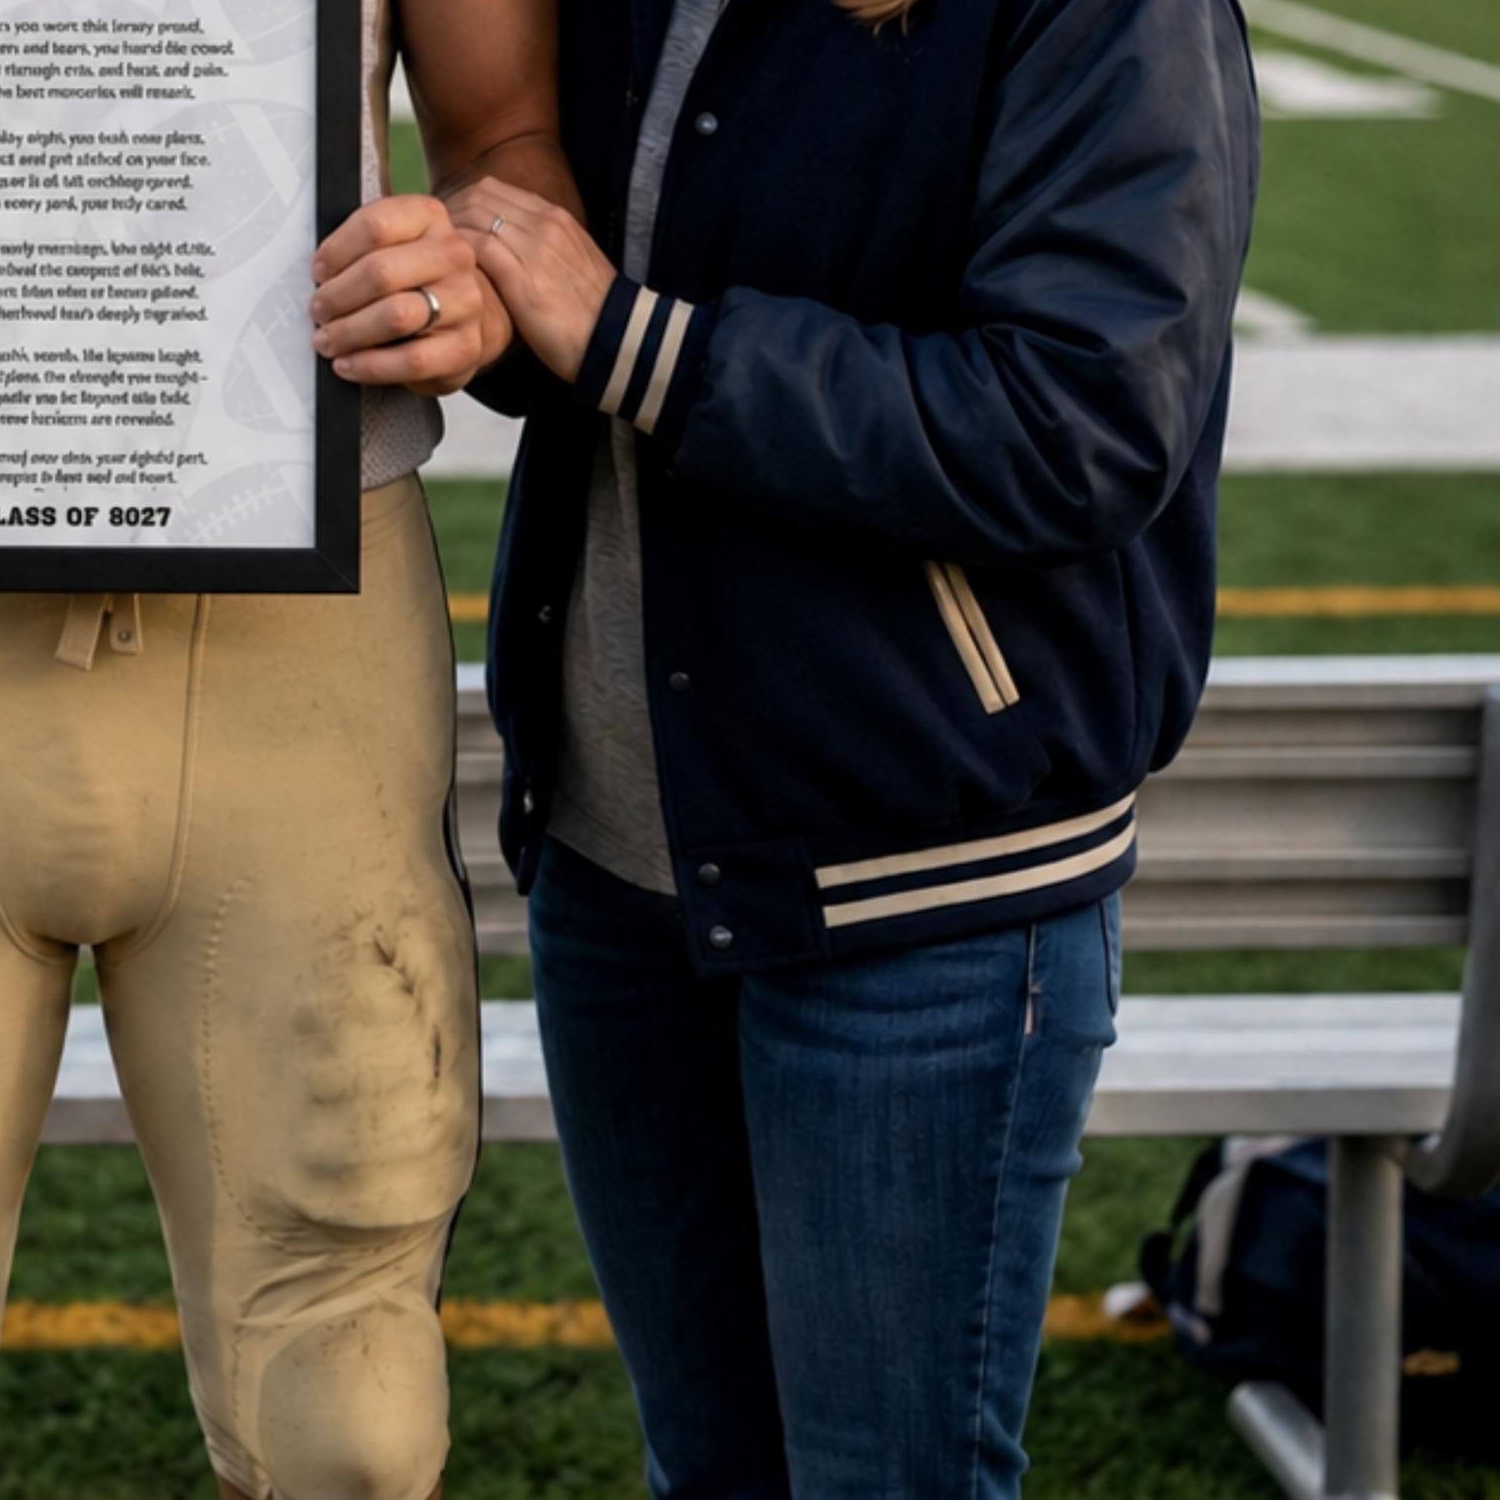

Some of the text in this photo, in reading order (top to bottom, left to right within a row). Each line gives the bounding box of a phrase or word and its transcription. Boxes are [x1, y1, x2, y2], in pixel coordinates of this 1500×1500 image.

[164, 62, 189, 77] and
[66, 506, 99, 527] OF
[108, 506, 171, 527] 8027
